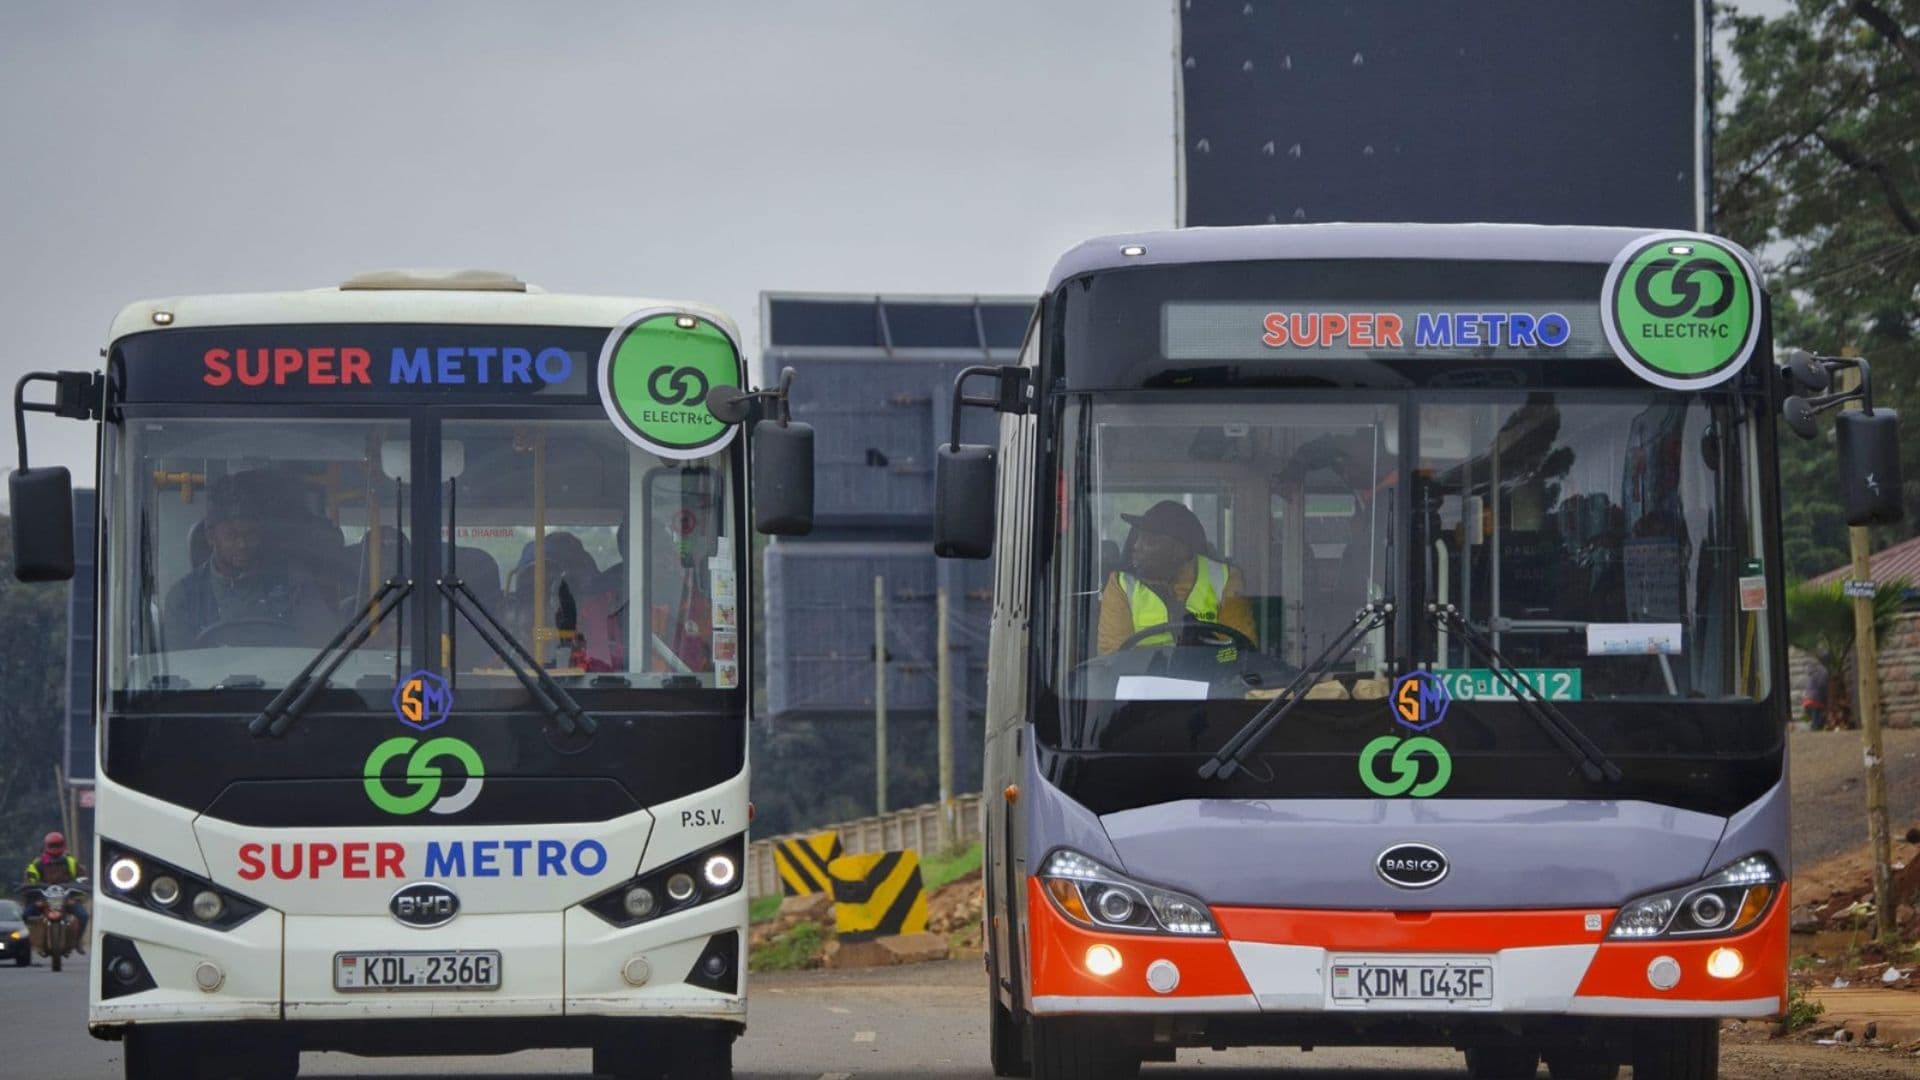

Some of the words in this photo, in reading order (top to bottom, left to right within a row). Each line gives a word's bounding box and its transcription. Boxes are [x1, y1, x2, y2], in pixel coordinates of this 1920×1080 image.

[1262, 312, 1404, 347] SUPER
[1415, 312, 1571, 347] METRO
[203, 348, 372, 386] SUPER
[389, 347, 573, 384] METRO
[681, 808, 725, 828] P.S.V.
[237, 842, 406, 881] SUPER
[424, 838, 608, 878] METRO
[397, 894, 452, 916] BYD
[363, 957, 415, 985] KDL
[427, 956, 492, 985] 236G
[1357, 968, 1408, 997] KDM
[1419, 968, 1485, 997] 043F
